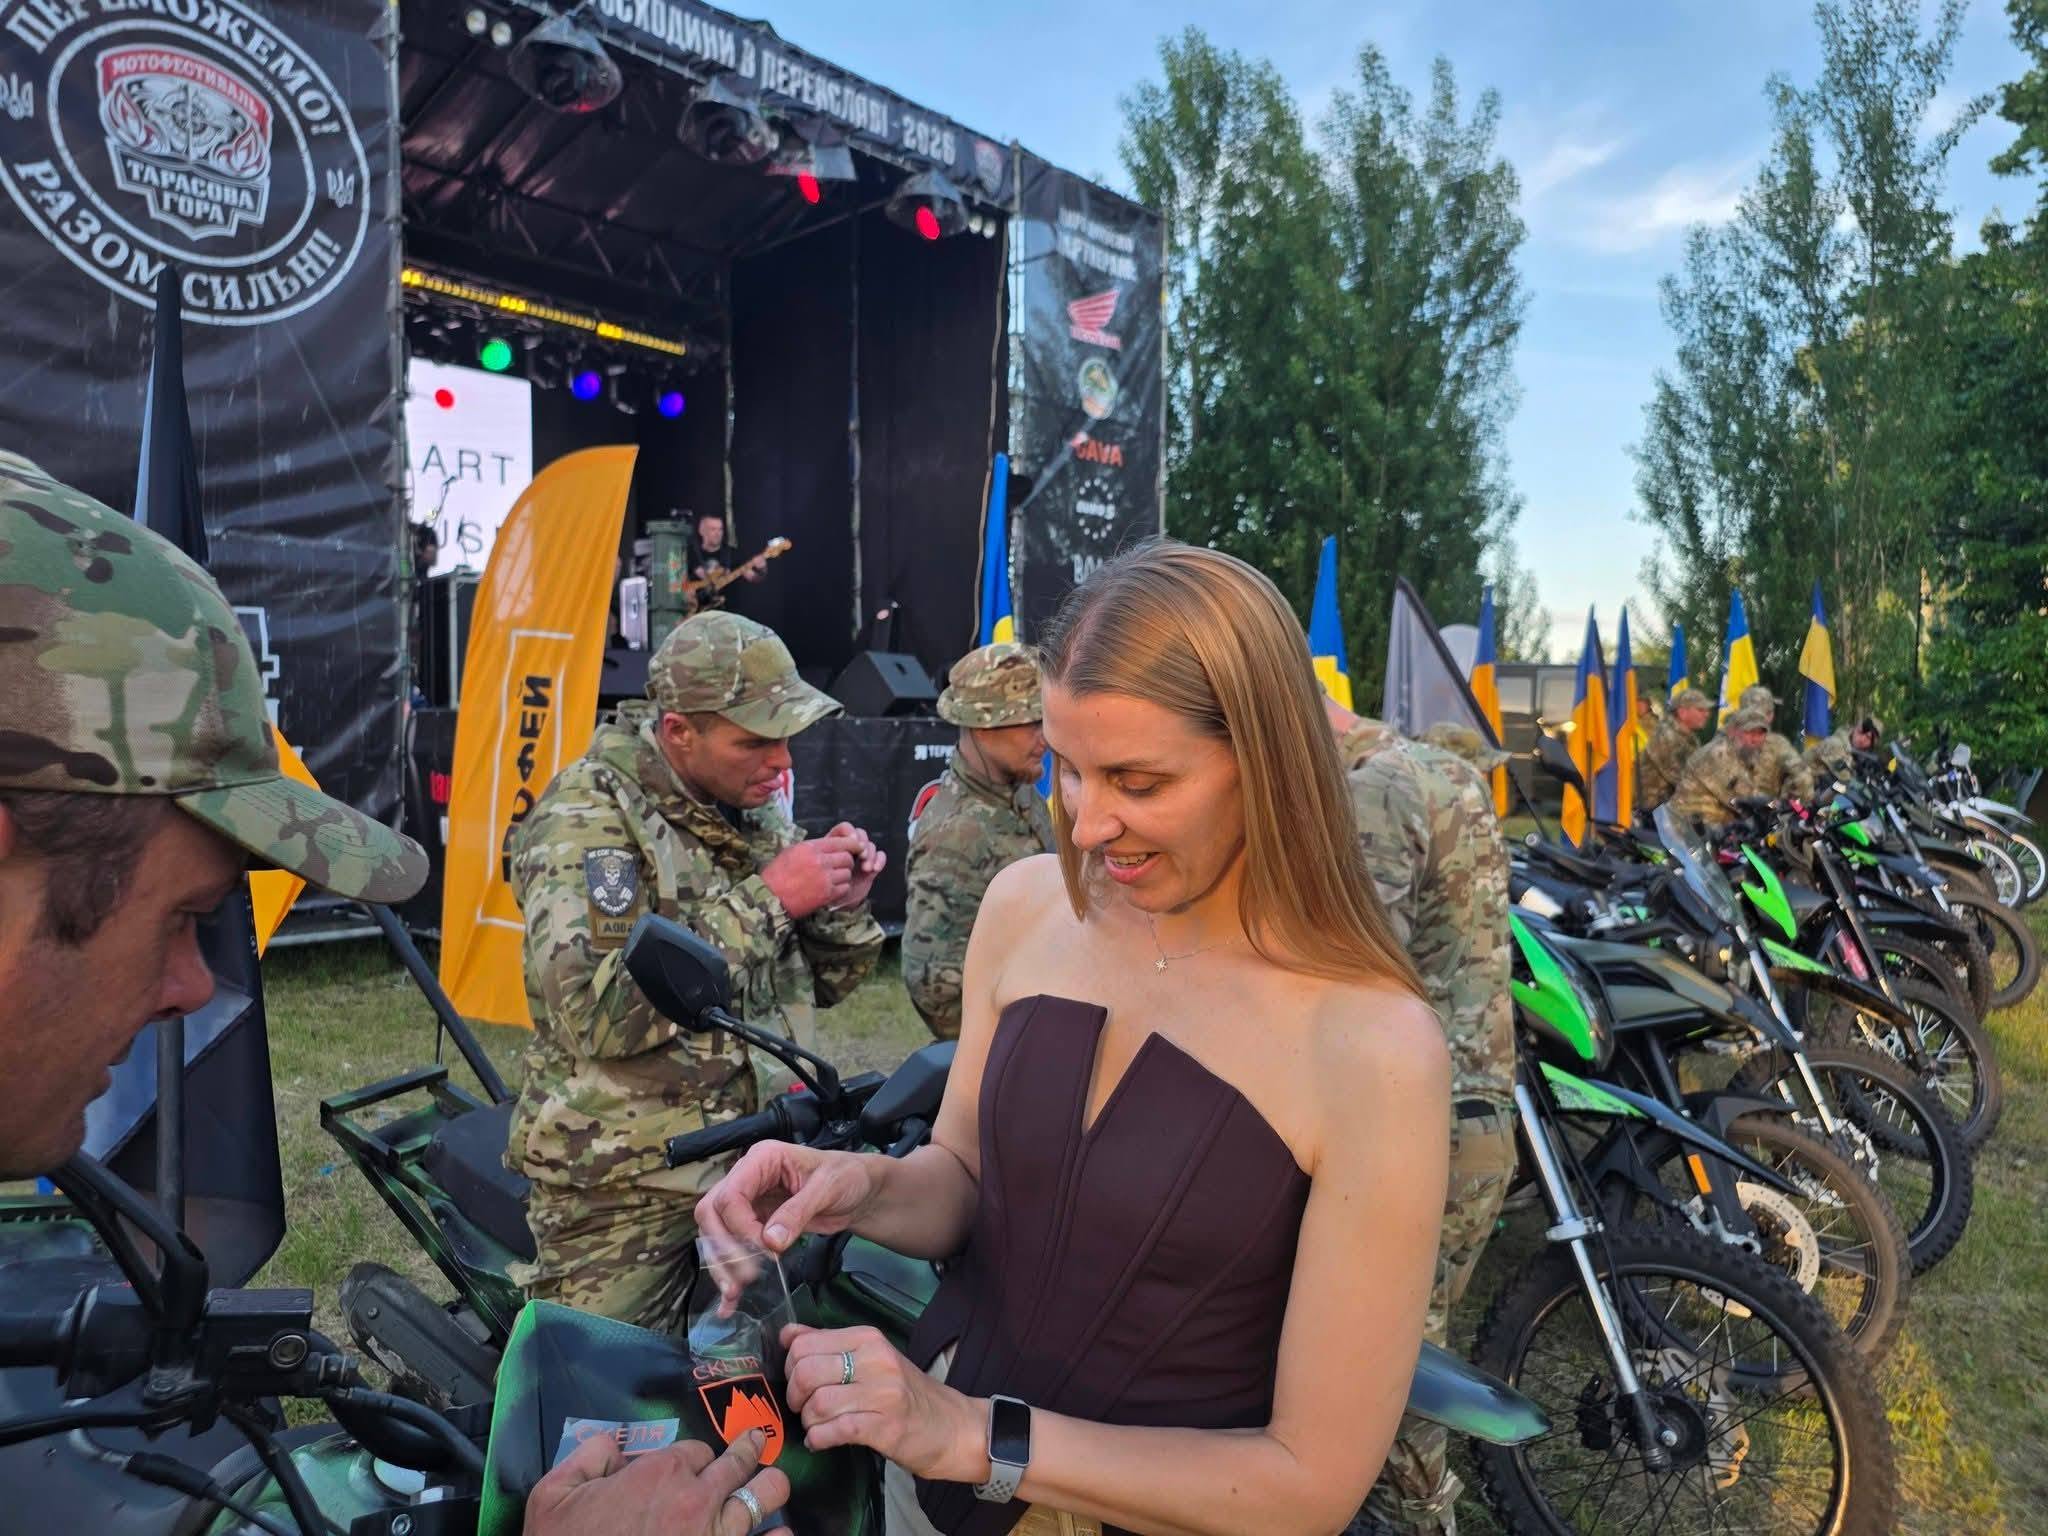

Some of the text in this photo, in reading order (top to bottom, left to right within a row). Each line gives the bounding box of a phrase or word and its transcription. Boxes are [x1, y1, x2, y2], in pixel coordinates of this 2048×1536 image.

[5, 0, 341, 136] ПЕОЖЕМО!
[112, 52, 259, 118] МОТОФЕСТИВАЛЬ
[739, 38, 757, 79] В
[127, 158, 255, 210] ТАРАСОВА
[162, 190, 226, 225] ГОРА
[14, 159, 343, 311] РАЗОМ СИЛЬНІ!
[420, 444, 515, 486] ART
[501, 674, 552, 882] ОФЕЙ
